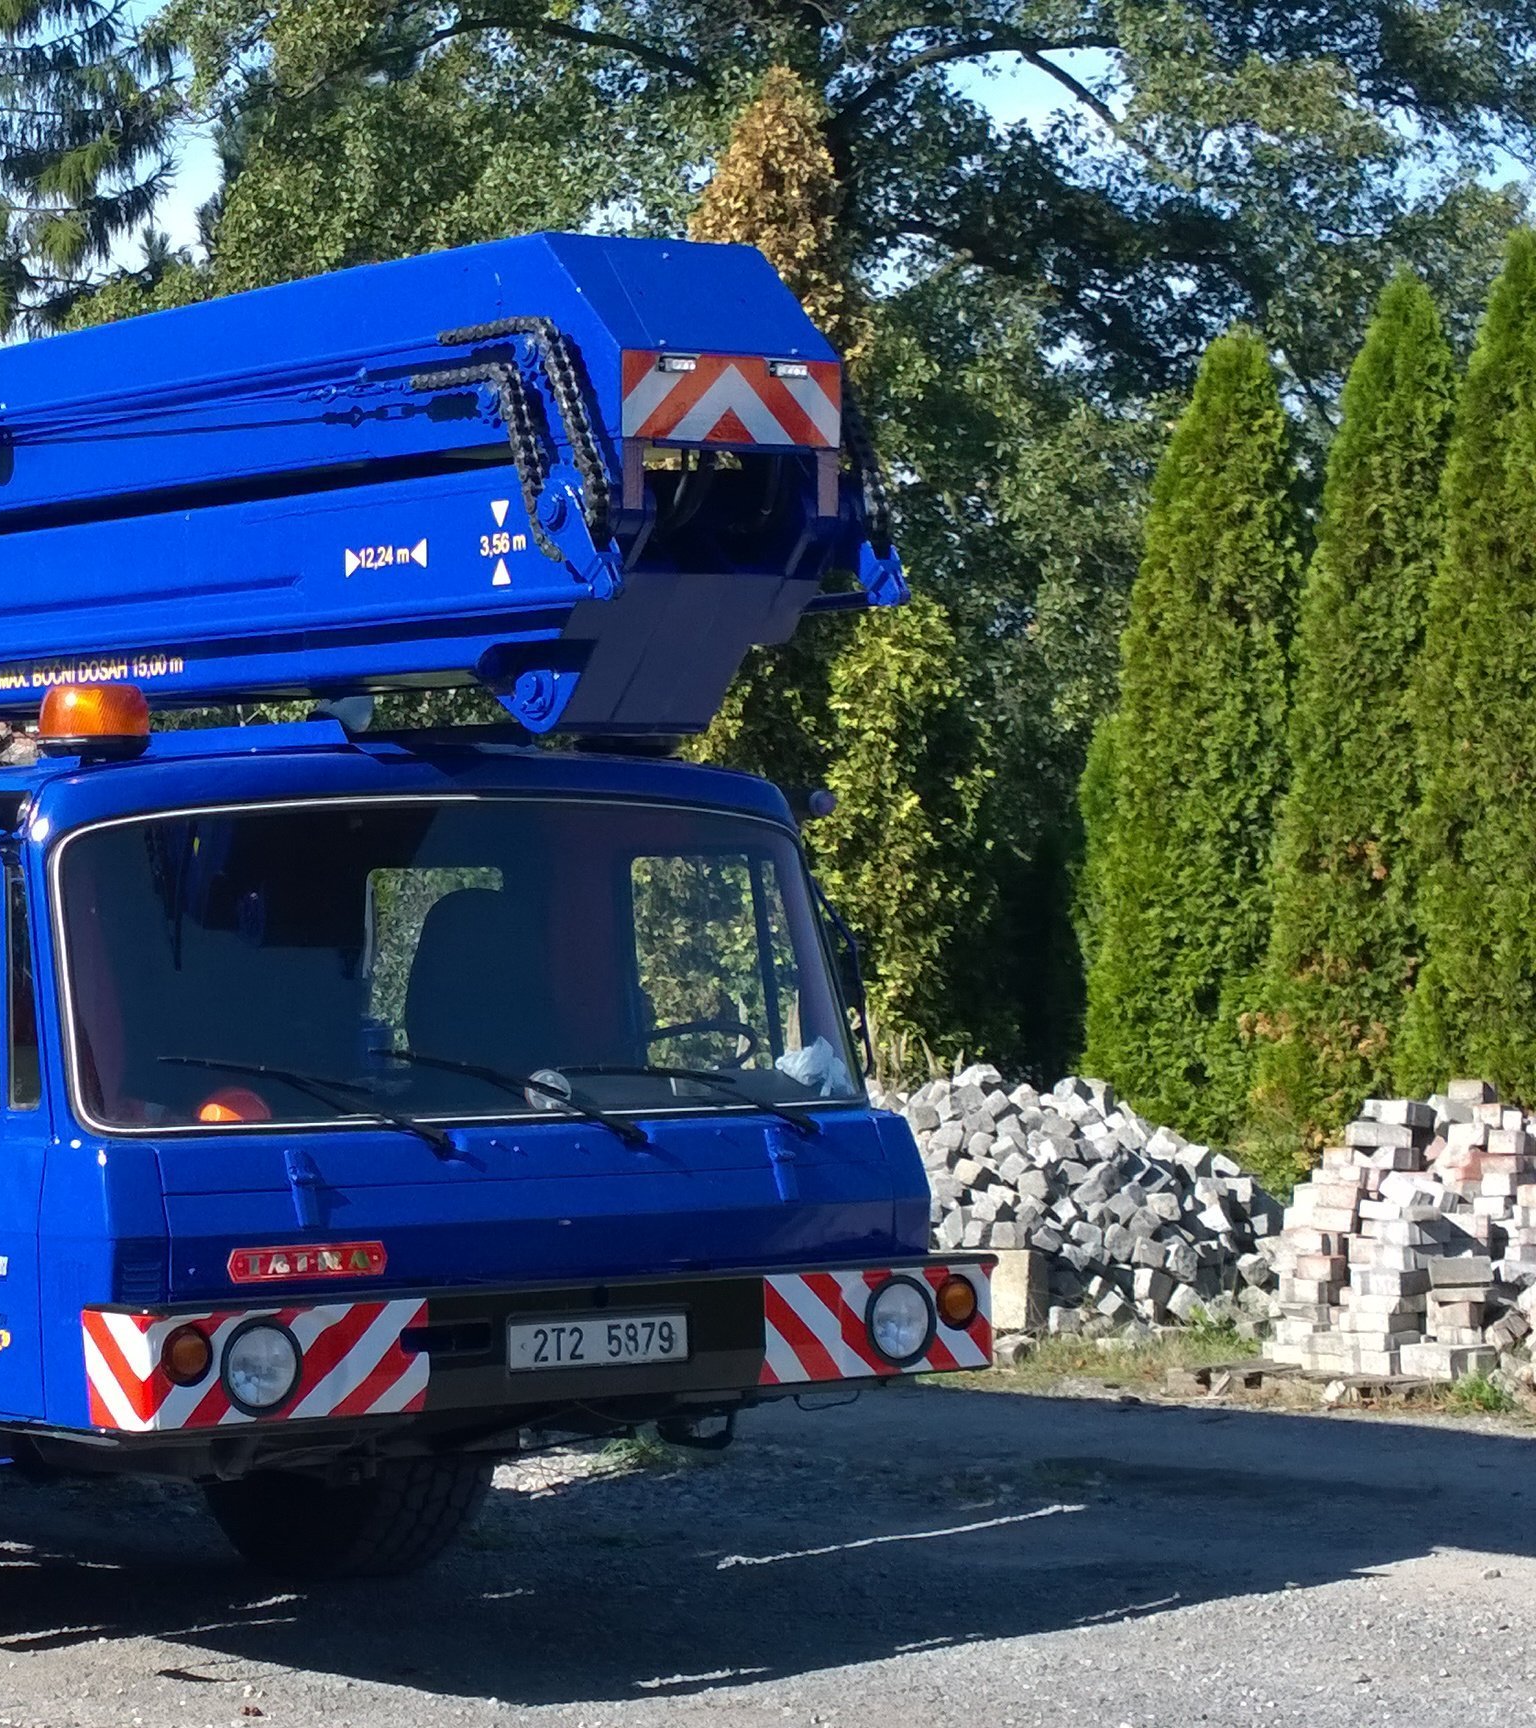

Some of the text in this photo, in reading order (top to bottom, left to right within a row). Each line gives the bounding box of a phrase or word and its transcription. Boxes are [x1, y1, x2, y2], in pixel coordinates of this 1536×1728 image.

[480, 532, 526, 557] 3,56 m
[359, 546, 410, 570] 12,24 m
[32, 660, 76, 687] BOČNÍ
[78, 659, 128, 683] DOSAH
[132, 654, 167, 679] 15,00
[170, 657, 183, 673] m
[244, 1250, 371, 1275] TATRA
[532, 1321, 675, 1362] 2T2 5879
